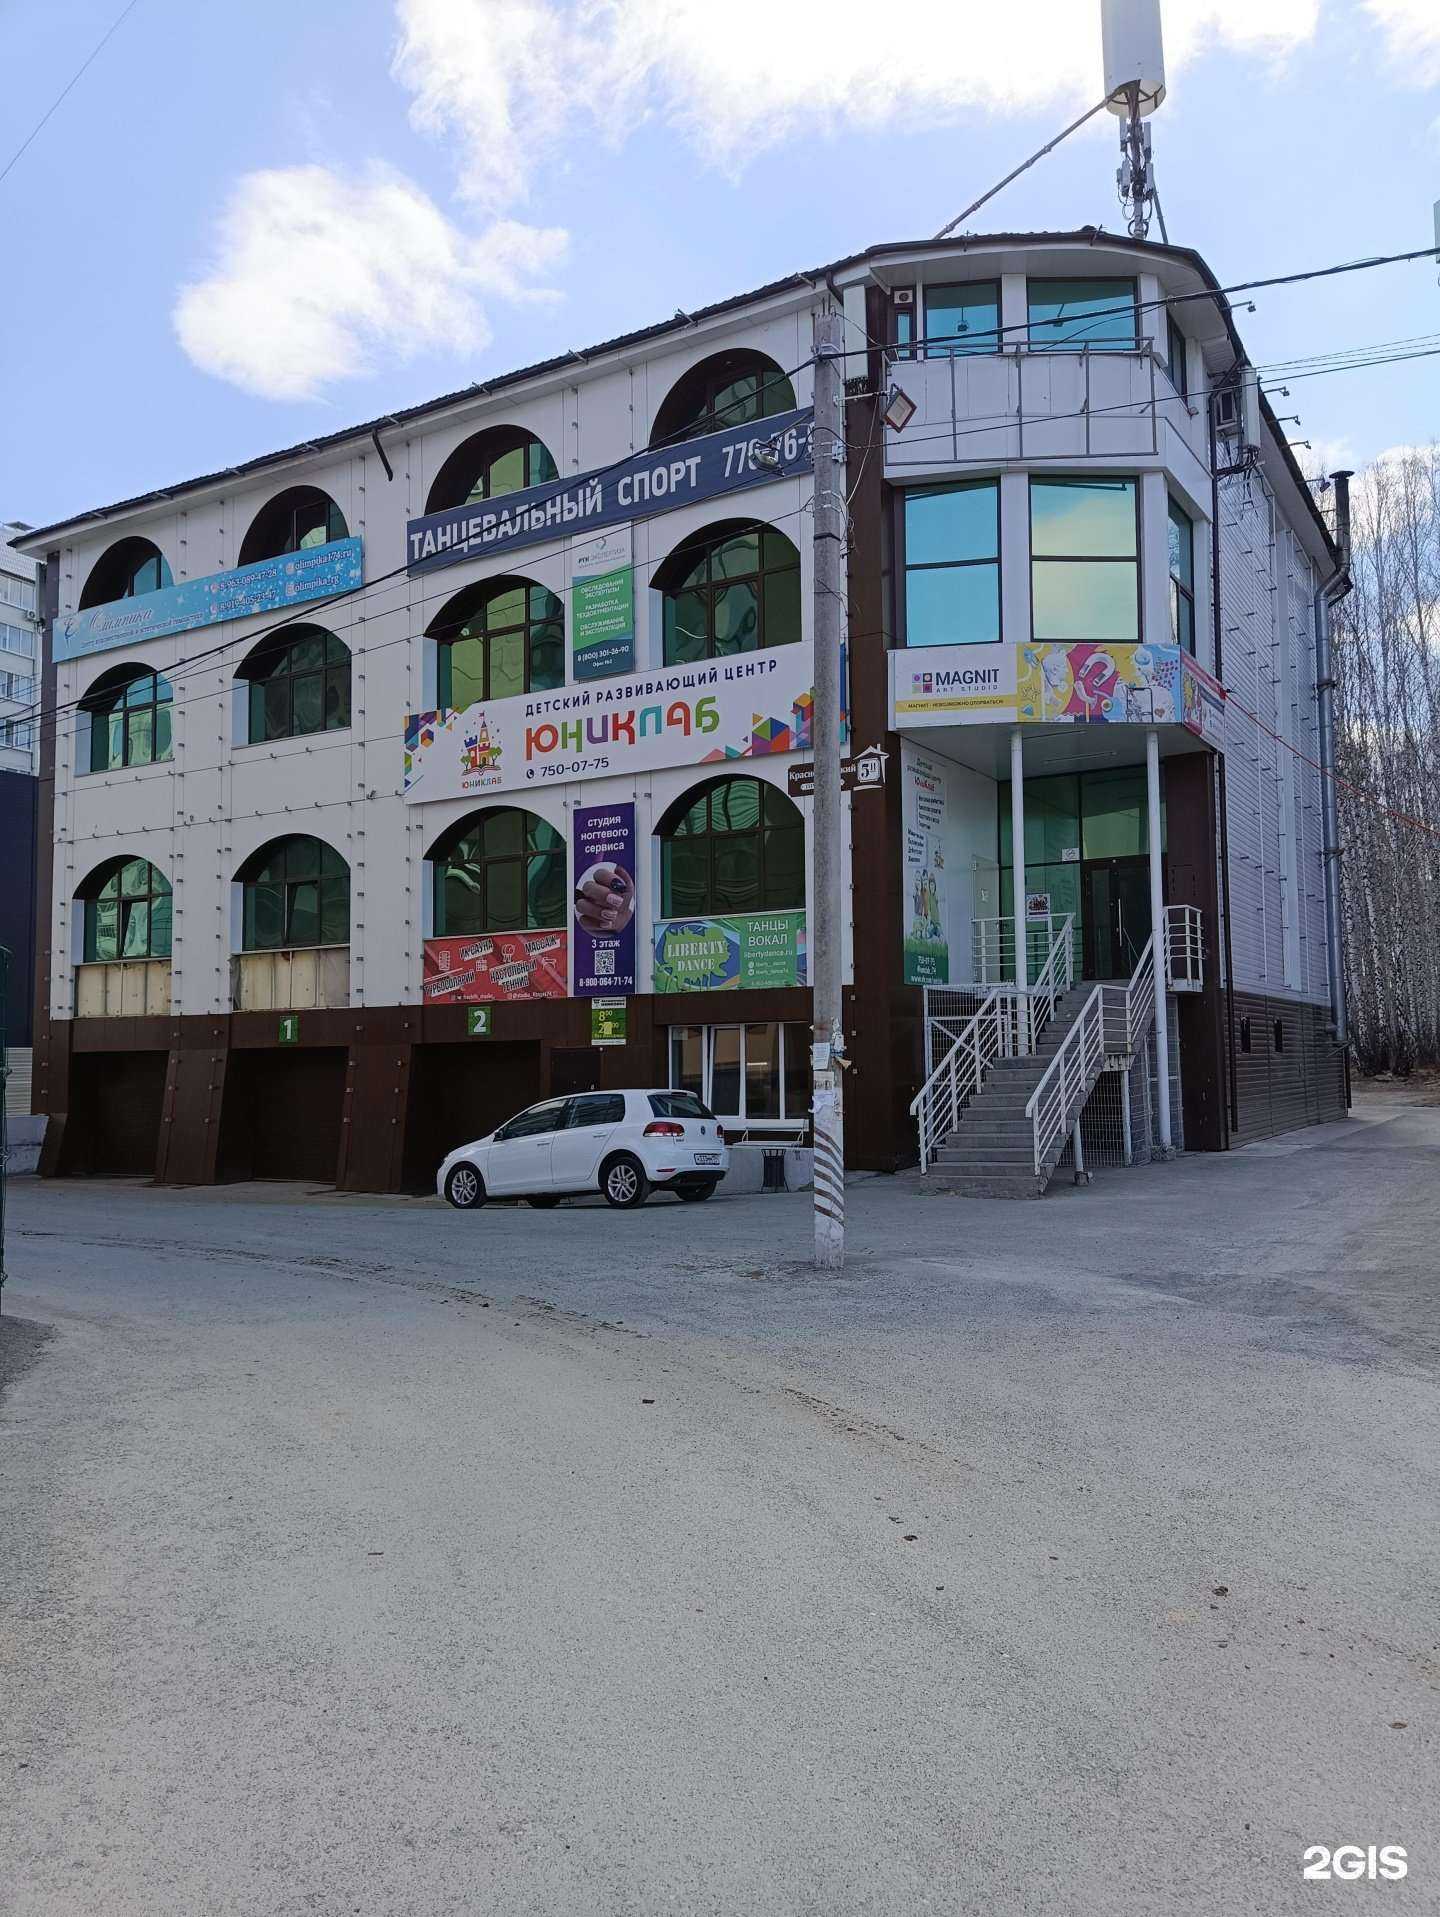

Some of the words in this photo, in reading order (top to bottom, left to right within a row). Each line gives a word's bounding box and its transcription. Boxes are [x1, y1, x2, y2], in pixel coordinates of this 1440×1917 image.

[410, 478, 602, 560] ТАНЦЕВАЛЬНЫЙ
[617, 456, 701, 506] СПОРТ
[935, 668, 1000, 686] MAGNIT
[525, 691, 591, 717] ДЕТСКИЙ
[597, 667, 718, 703] РАЗВИВАЮЩИЙ
[725, 659, 777, 681] ЦЕНТР
[962, 684, 998, 692] STUDIO
[525, 696, 720, 761] ЮНИКЛАБ
[540, 757, 609, 777] 750-07-75
[462, 776, 502, 789] ЮНИКЛАБ
[587, 816, 621, 828] студия
[581, 828, 629, 840] ногтевого
[585, 842, 625, 854] сервиса
[747, 919, 789, 932] ТАНЦЫ
[525, 933, 558, 953] МАССАЖ
[591, 939, 597, 949] 3
[599, 939, 621, 948] этаж
[748, 934, 788, 946] ВОКАЛ
[667, 940, 727, 958] LIBERTY
[744, 949, 793, 960] libertydance.ru
[677, 959, 715, 972] DANCE
[473, 1010, 487, 1033] 2
[283, 1019, 292, 1039] 1
